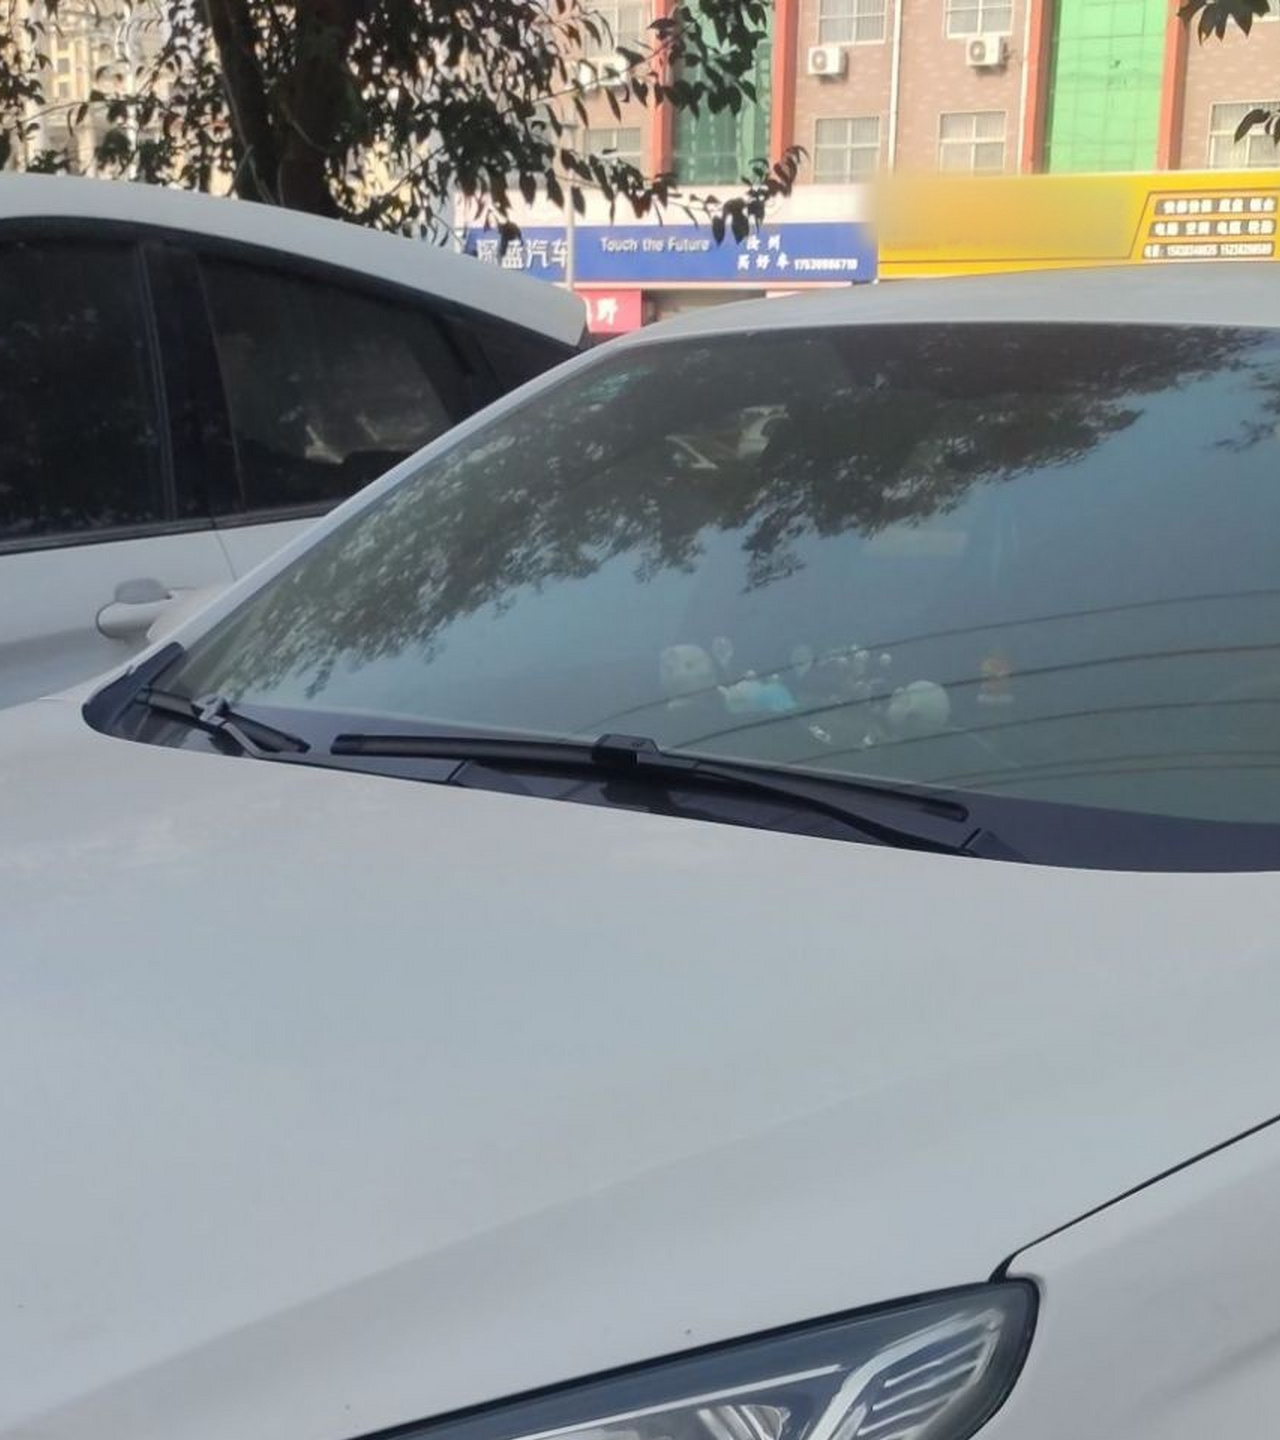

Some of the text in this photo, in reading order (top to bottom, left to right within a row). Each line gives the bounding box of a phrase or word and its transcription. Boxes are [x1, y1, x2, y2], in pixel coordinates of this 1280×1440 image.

[601, 237, 710, 251] Touch the Future
